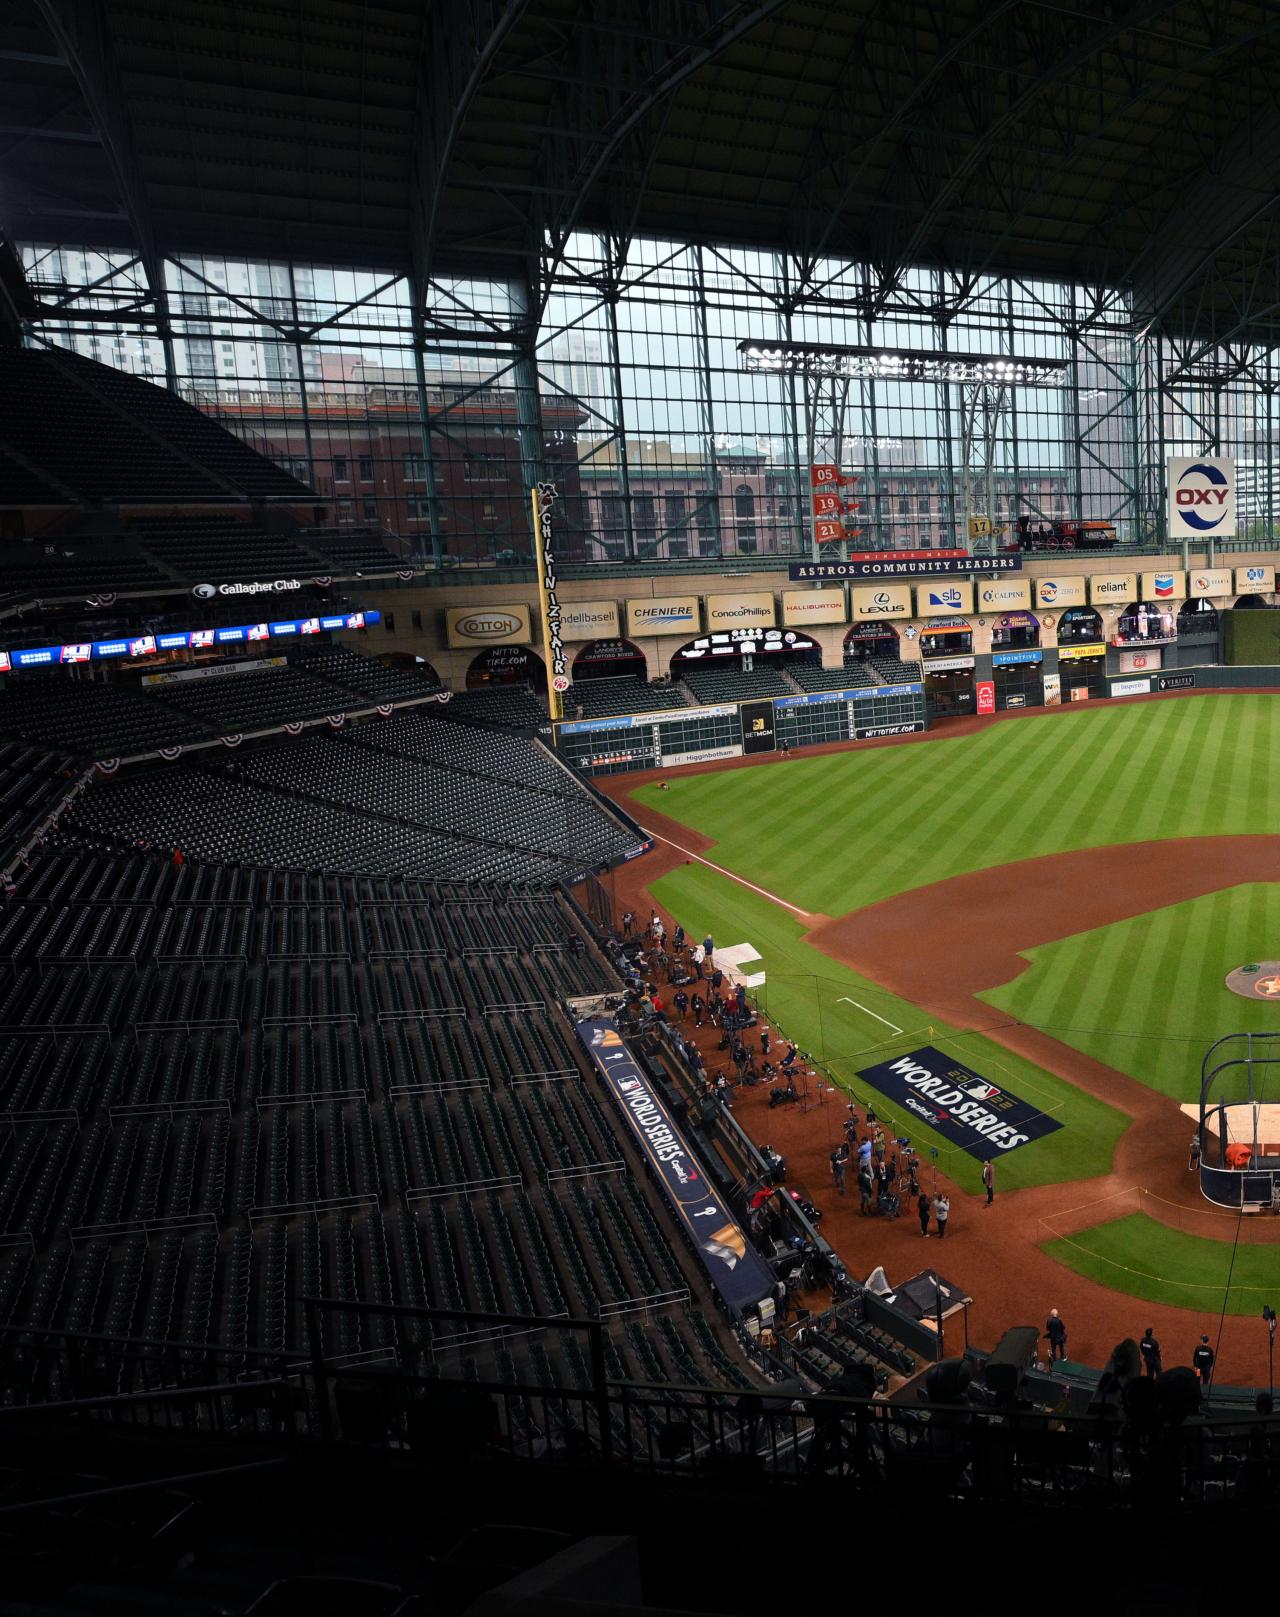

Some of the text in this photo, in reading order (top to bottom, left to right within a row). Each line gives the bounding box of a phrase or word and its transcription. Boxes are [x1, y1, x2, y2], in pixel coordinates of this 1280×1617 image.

[817, 468, 833, 480] 05
[1176, 489, 1229, 505] OXY
[820, 498, 835, 509] 19
[820, 525, 835, 536] 21
[973, 521, 986, 532] 17
[799, 558, 1015, 577] ASTROS COMMUNITY LEADERS
[219, 581, 273, 596] Gallagher
[275, 579, 301, 590] Club
[1097, 582, 1127, 592] reliant
[541, 512, 564, 675] CHIKIN IZ FAIR
[942, 588, 961, 600] slb
[994, 591, 1025, 599] CALPINE
[634, 606, 693, 617] CHENIERE
[712, 607, 771, 618] ConocoPhillips
[786, 603, 842, 611] HALLIBURTON
[859, 605, 905, 614] LEXUS
[559, 611, 615, 625] ndellbasell
[464, 619, 513, 633] COTTON
[493, 648, 519, 656] NITTO
[486, 655, 527, 667] TIRE.COM
[745, 729, 773, 739] BETMGM
[686, 750, 734, 762] Higginbotham
[889, 1056, 1030, 1150] WORLD SERIES
[624, 1086, 684, 1162] WORLD SERIES
